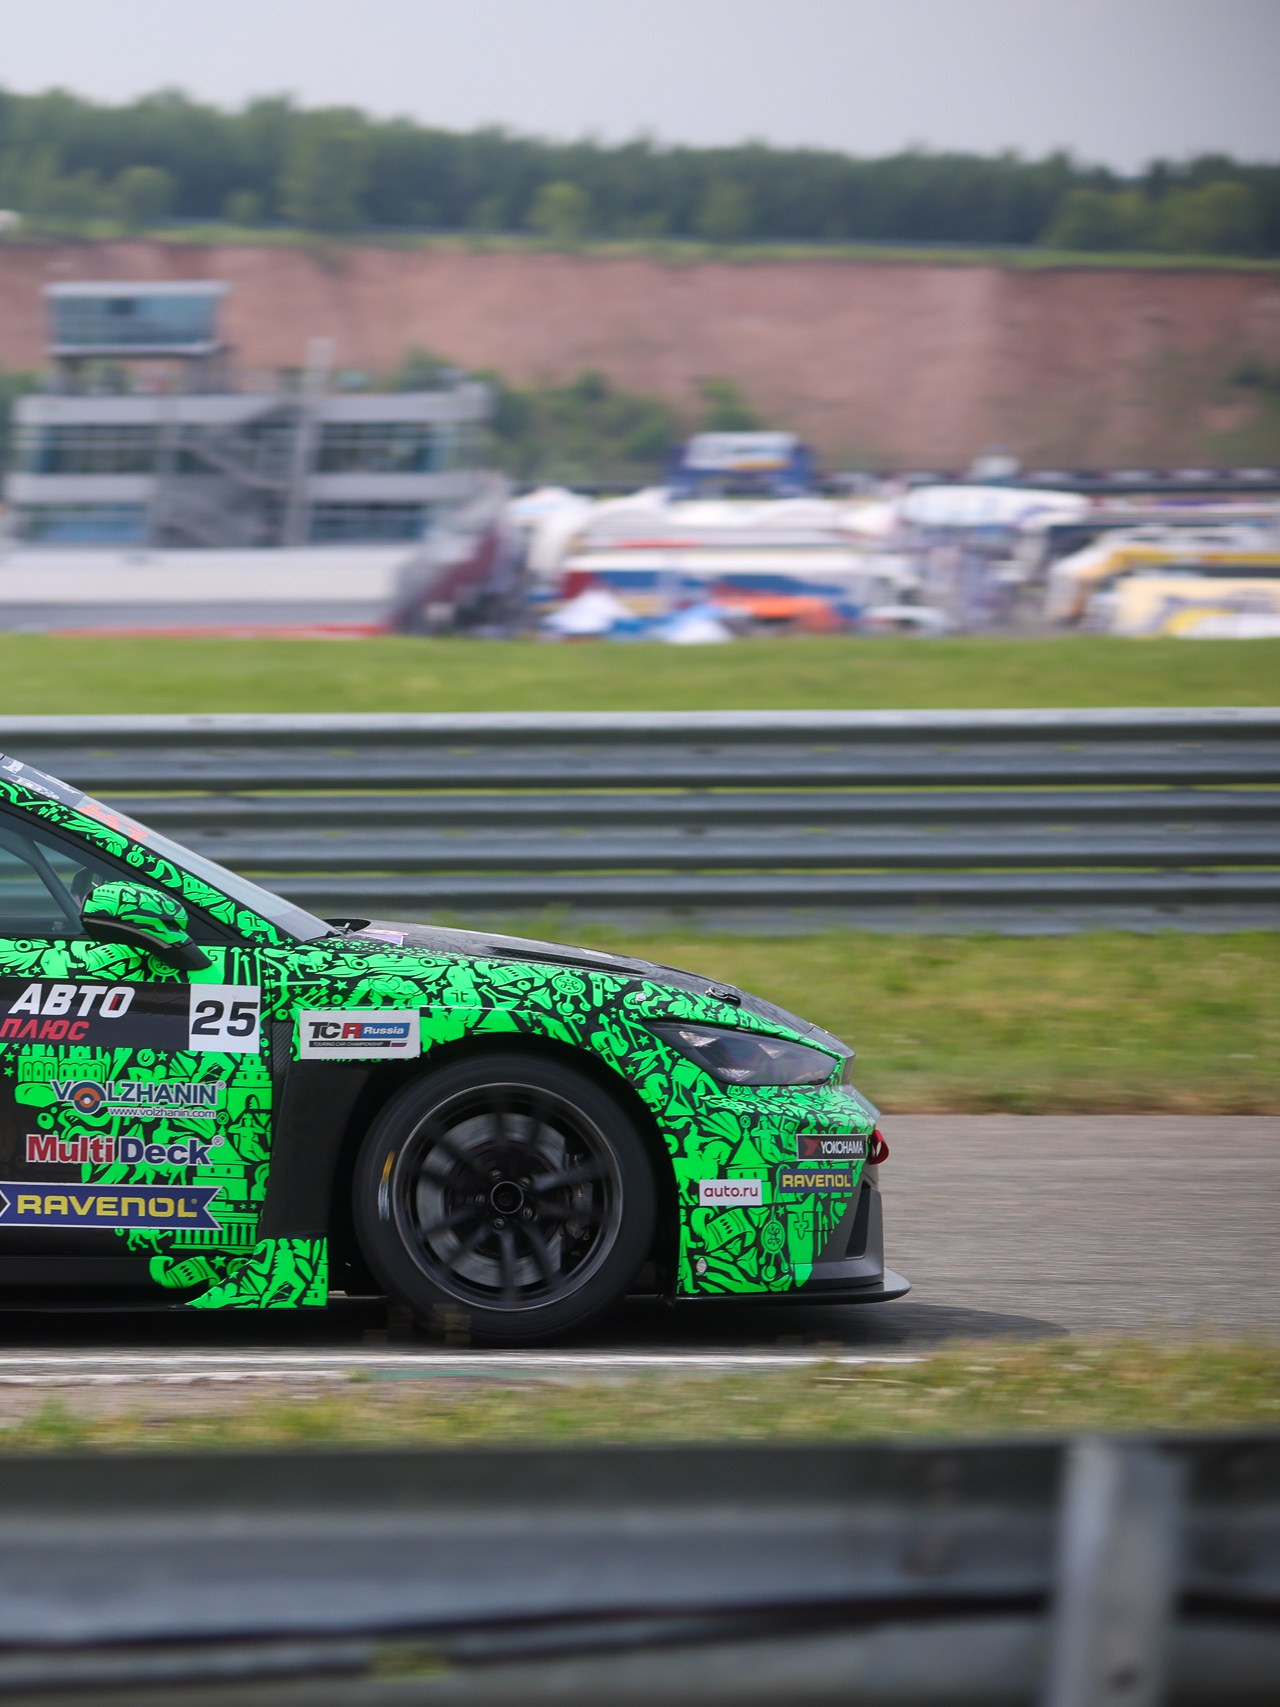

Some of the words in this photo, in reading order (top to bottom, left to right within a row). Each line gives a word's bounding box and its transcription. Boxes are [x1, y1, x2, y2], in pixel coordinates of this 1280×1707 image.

[8, 983, 135, 1018] АВТО
[191, 999, 259, 1037] 25
[309, 1021, 363, 1039] TCR
[363, 1026, 405, 1035] Russia
[51, 1080, 218, 1115] VOLZHANIN
[108, 1107, 217, 1119] www.volzhanin.com
[820, 1140, 864, 1155] YOKOHAMA
[782, 1173, 851, 1188] RAVENOL
[704, 1185, 759, 1198] auto.ru
[17, 1194, 198, 1218] RAVENOL
